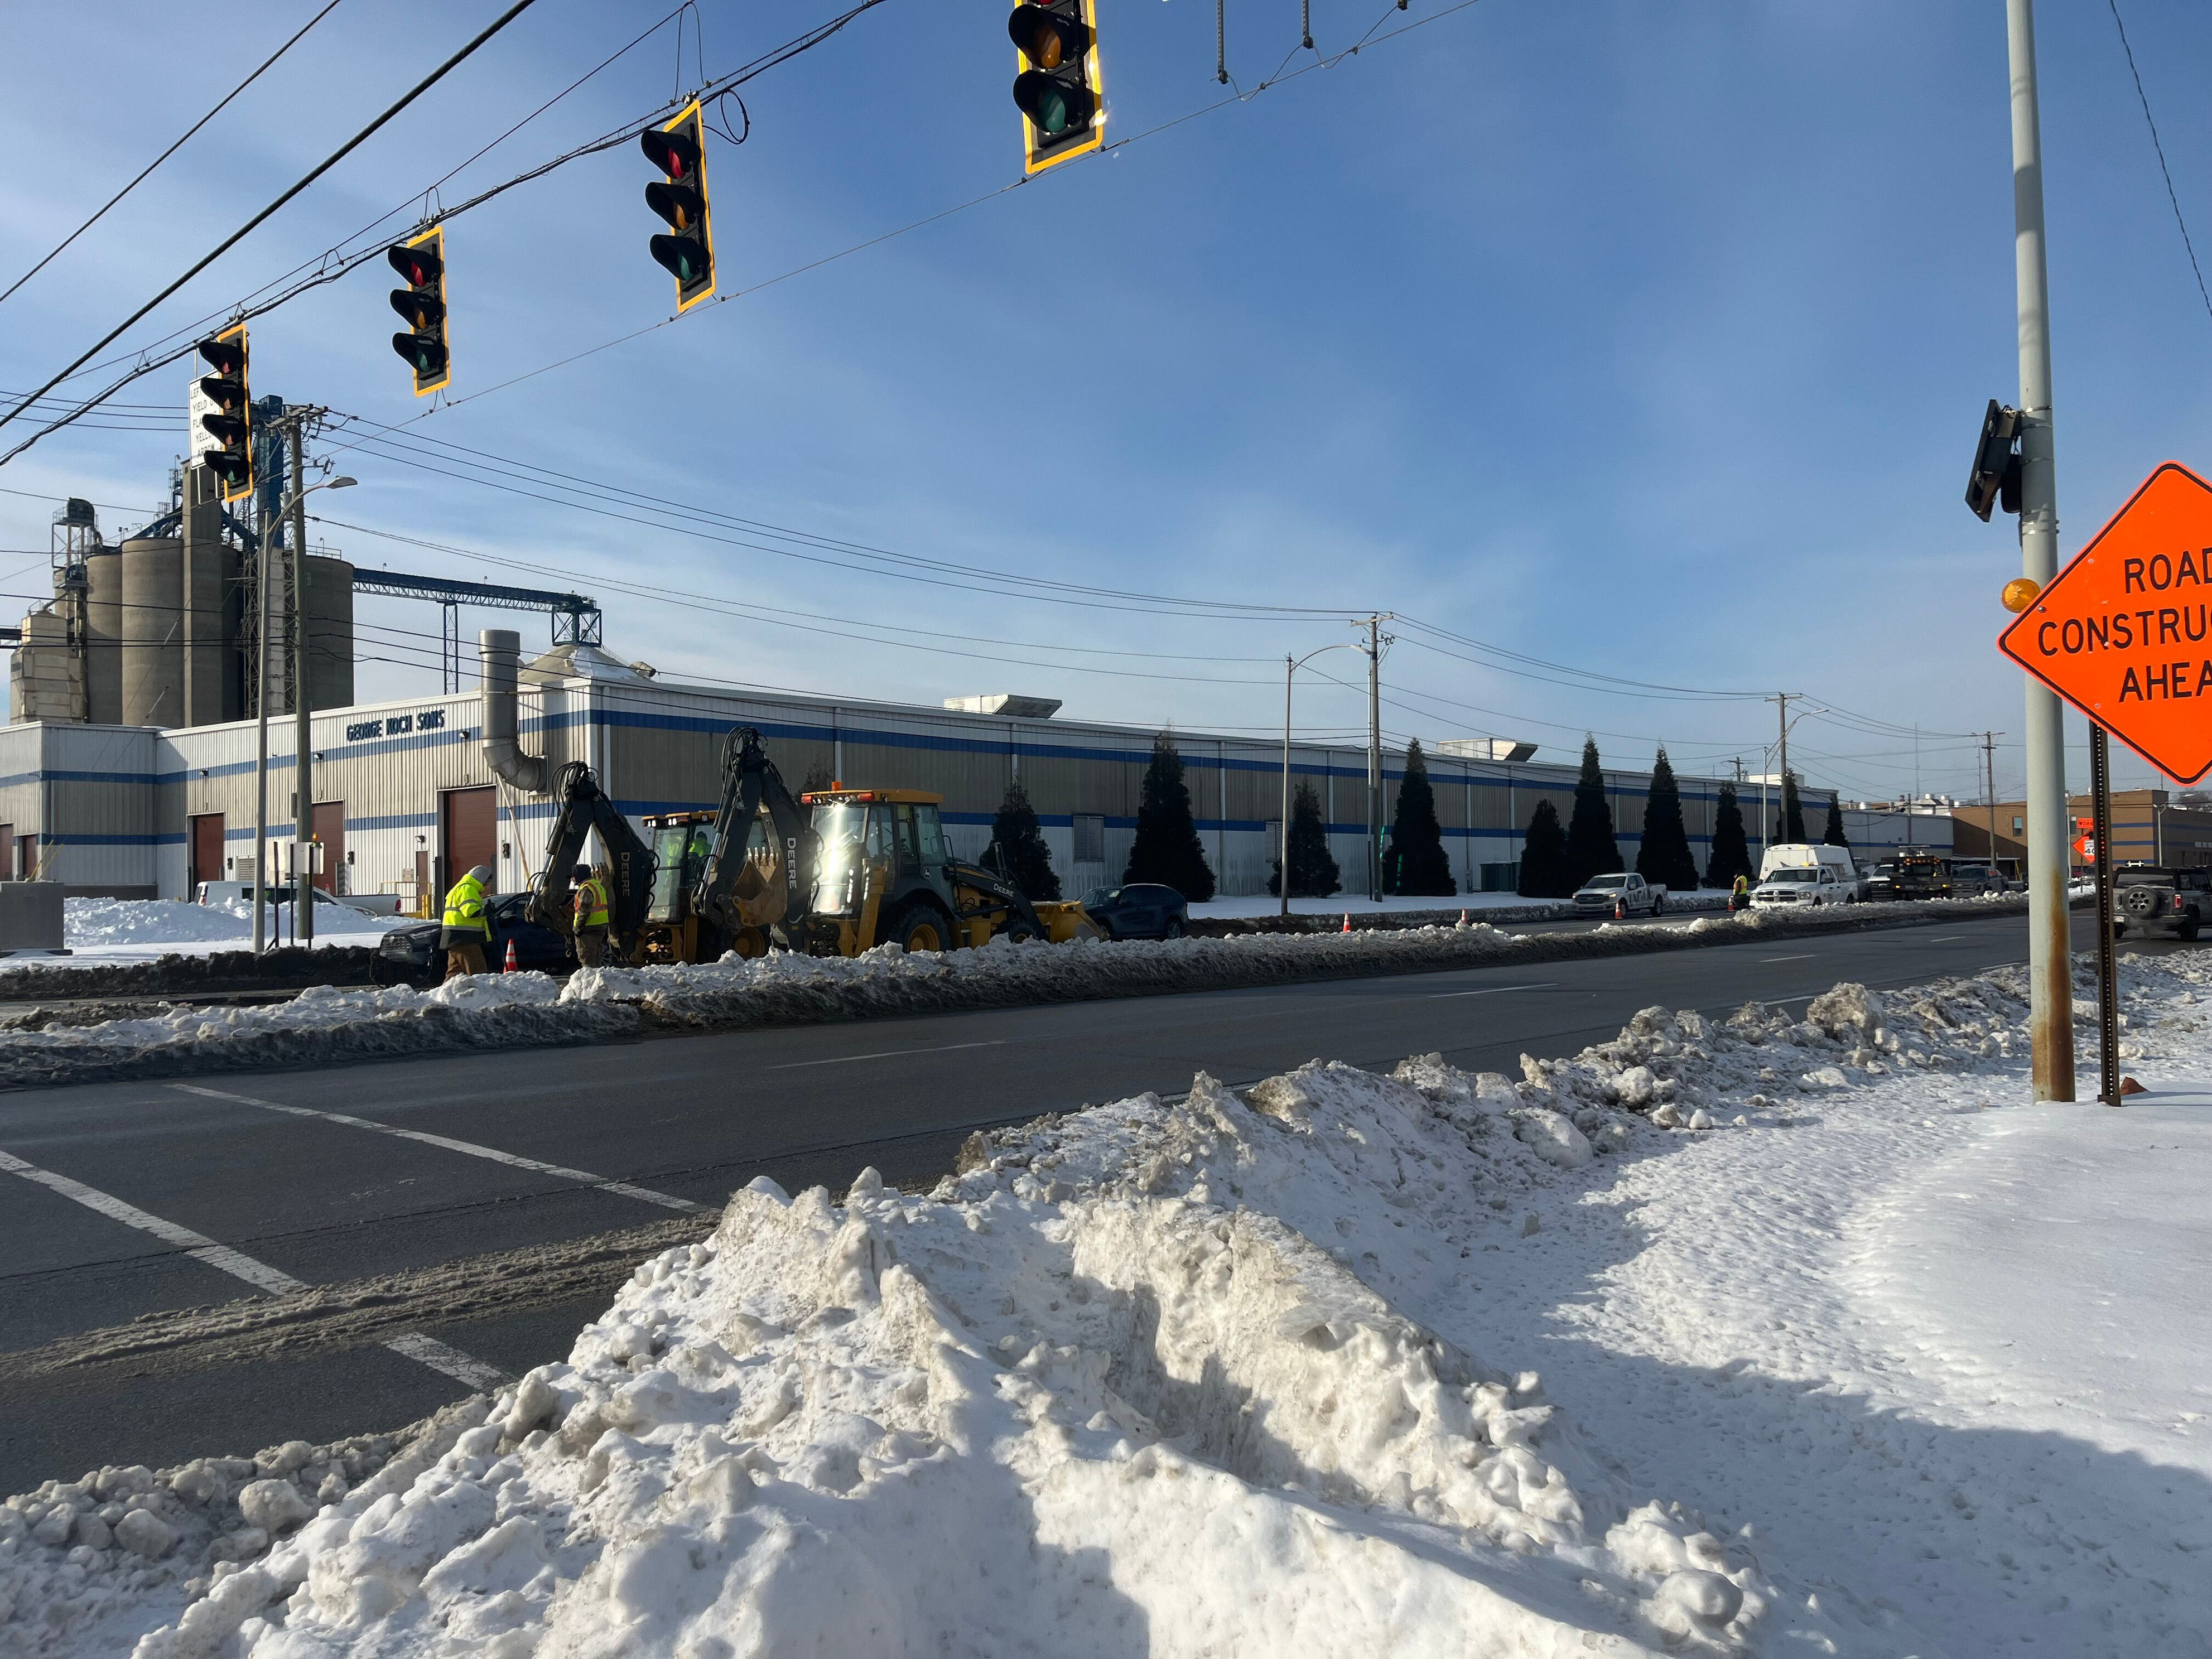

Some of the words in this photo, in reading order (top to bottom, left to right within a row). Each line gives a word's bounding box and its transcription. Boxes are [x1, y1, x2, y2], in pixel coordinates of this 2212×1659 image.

[192, 399, 207, 413] YIELD
[2038, 604, 2212, 657] CONSTRU
[346, 720, 382, 742] GEORGE
[386, 715, 412, 736] KOCH
[416, 709, 445, 731] SONS
[620, 851, 630, 897] DEERE
[787, 837, 797, 890] DEERE
[993, 883, 1014, 898] DEERE
